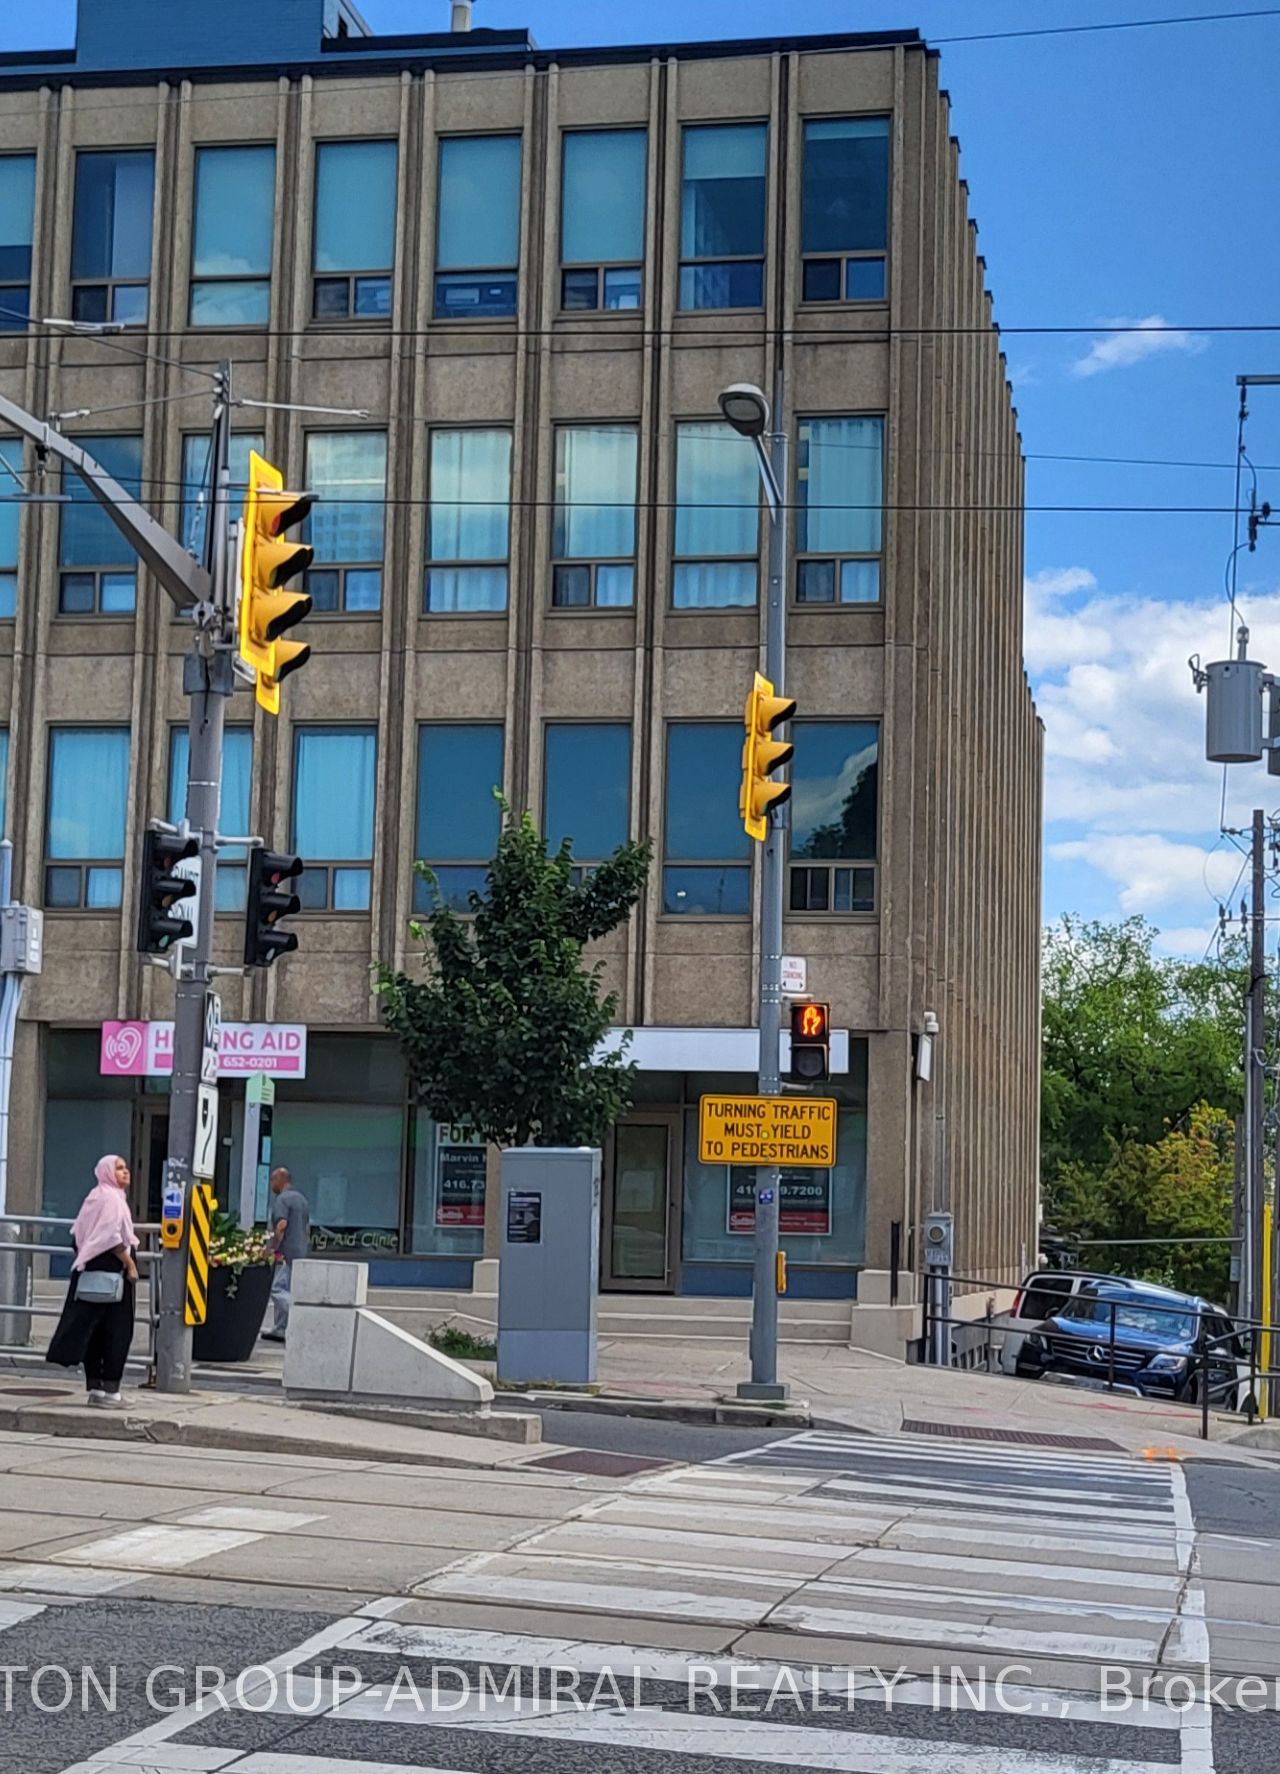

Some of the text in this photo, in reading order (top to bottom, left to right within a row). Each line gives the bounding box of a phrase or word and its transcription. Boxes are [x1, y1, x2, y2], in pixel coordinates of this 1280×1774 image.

[261, 1031, 301, 1051] AID
[222, 1055, 278, 1069] 652-0201
[705, 1102, 831, 1121] TURNING TRAFFIC
[723, 1122, 812, 1140] MUST YIELD
[705, 1140, 829, 1160] TO PEDESTRIANS
[332, 1231, 357, 1247] Aid
[360, 1231, 399, 1248] Clinic
